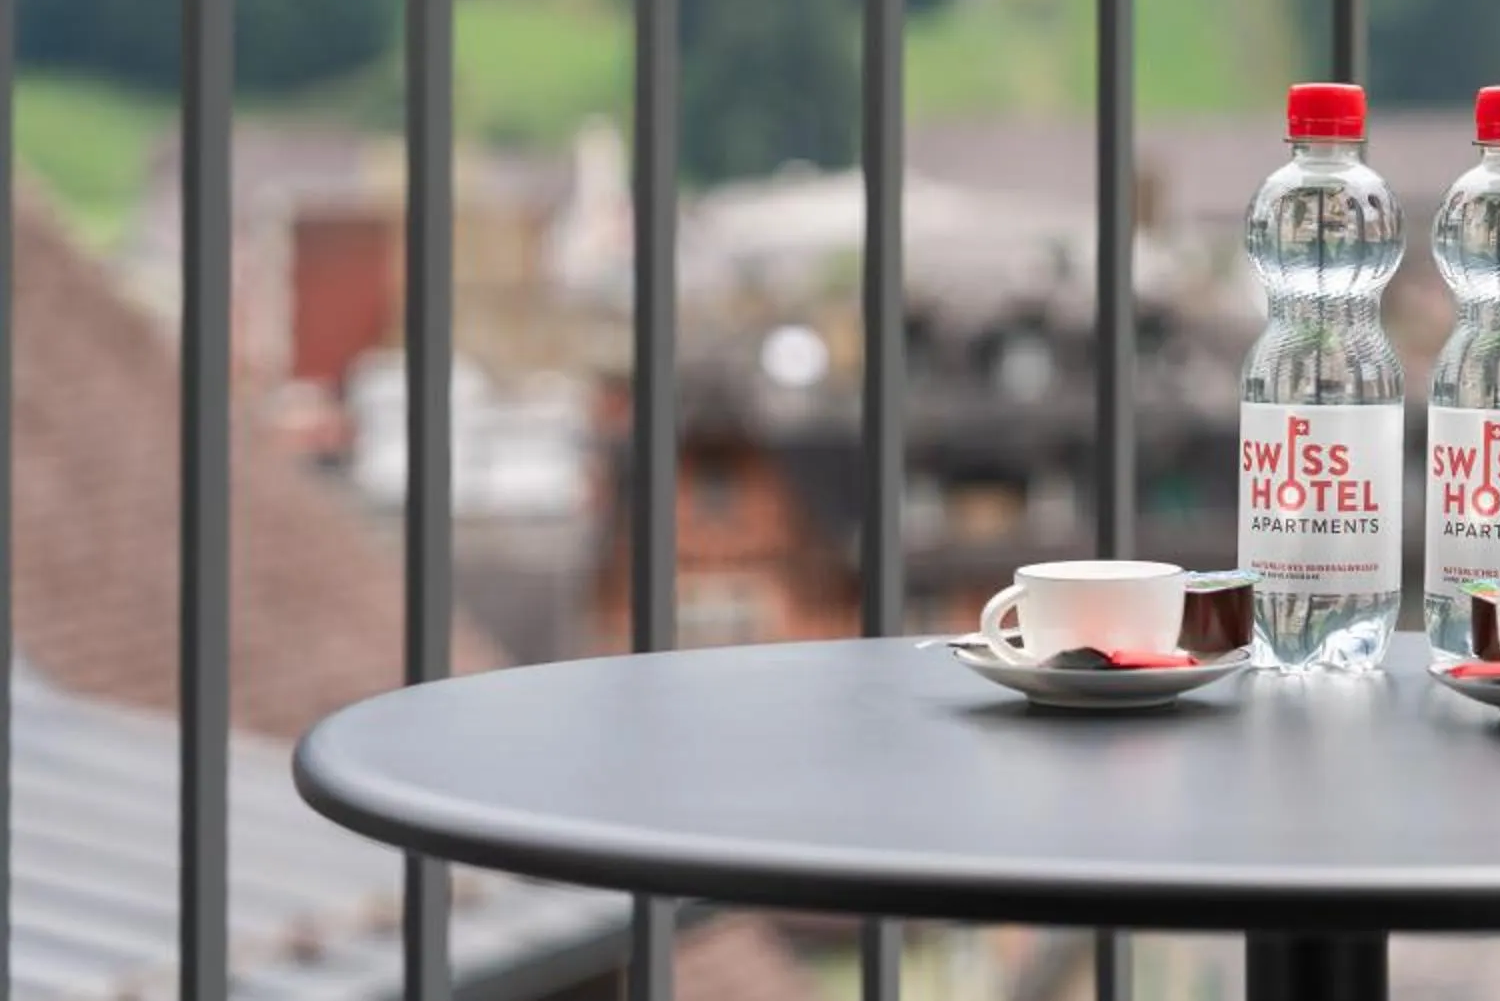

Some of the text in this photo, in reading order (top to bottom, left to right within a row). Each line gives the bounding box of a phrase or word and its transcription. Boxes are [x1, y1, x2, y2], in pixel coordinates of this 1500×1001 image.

[1243, 417, 1349, 476] SWISS
[1251, 478, 1378, 512] HOTEL
[1251, 517, 1379, 534] APARTMENTS
